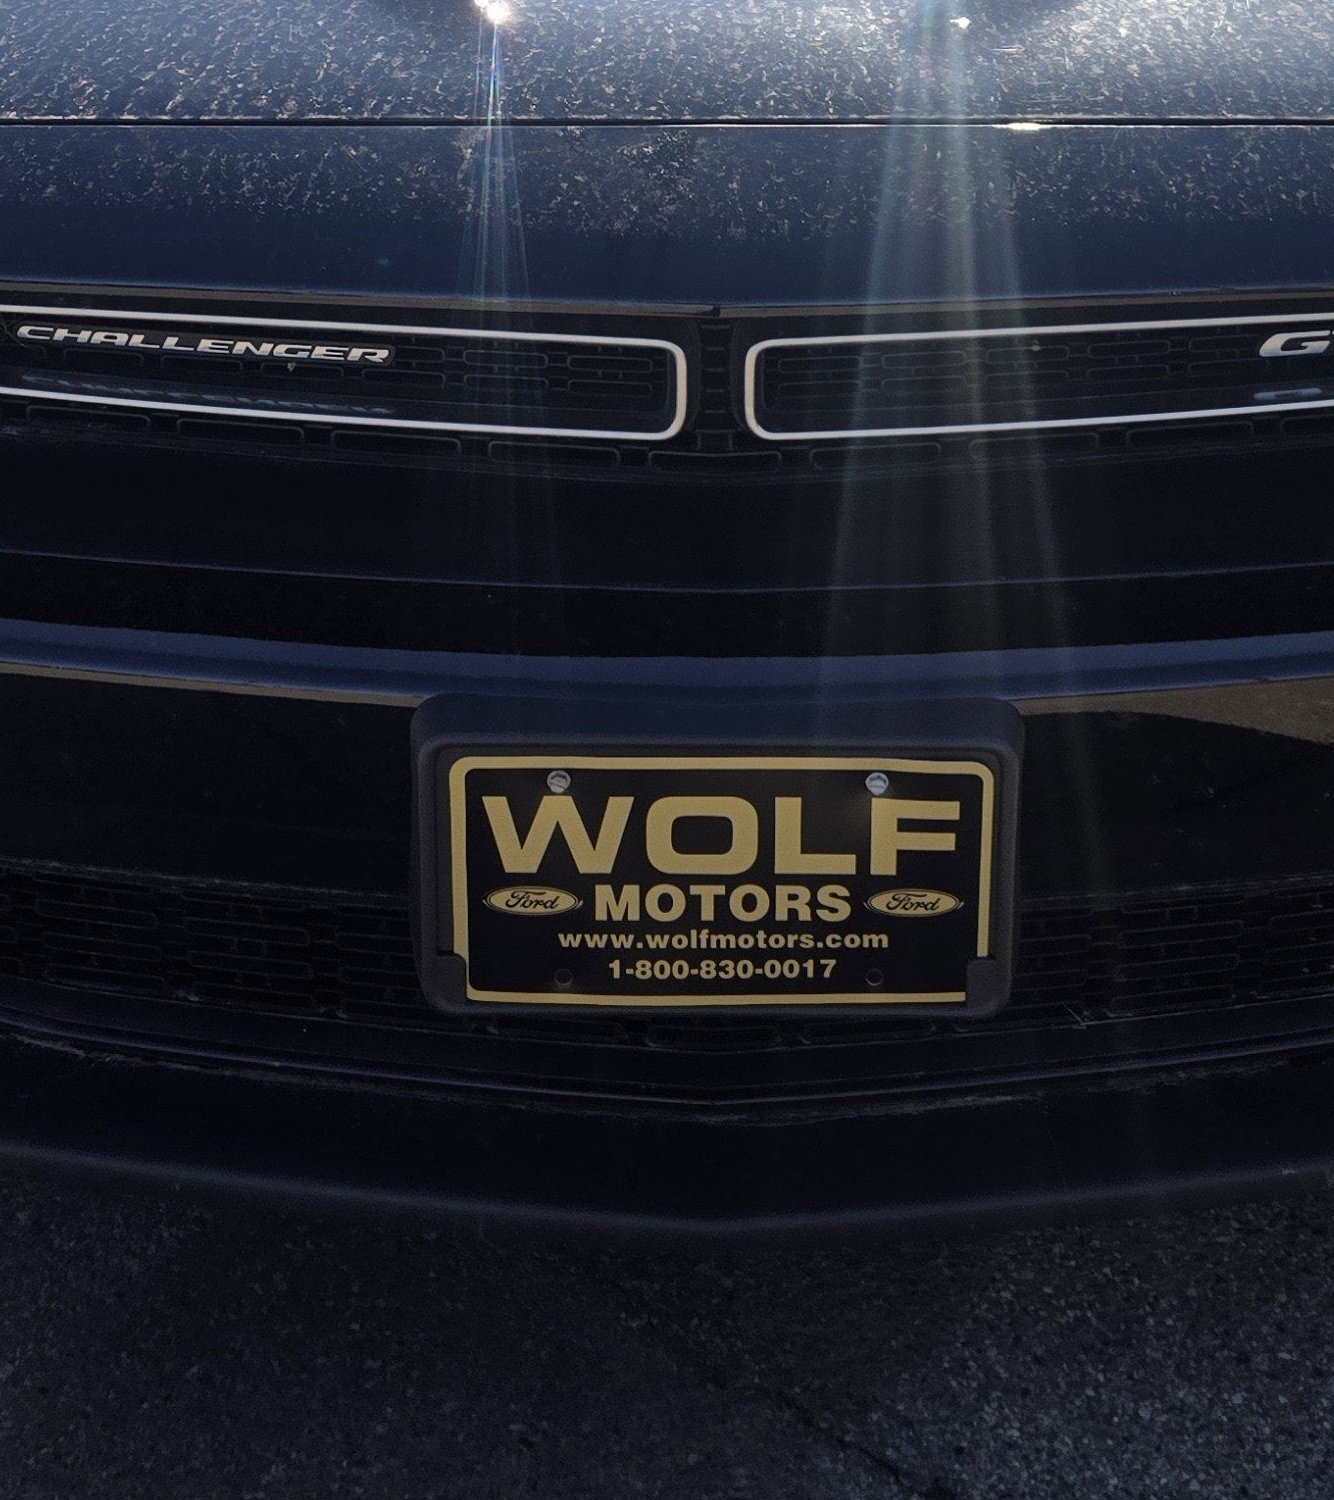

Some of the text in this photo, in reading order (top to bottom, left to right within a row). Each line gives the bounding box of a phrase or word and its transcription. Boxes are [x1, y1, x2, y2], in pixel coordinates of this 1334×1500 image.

[17, 324, 391, 364] CHALLENGER
[482, 795, 961, 876] WOLF
[504, 889, 560, 913] Ford
[594, 883, 852, 923] MOTORS
[885, 891, 940, 914] Ford
[557, 928, 889, 950] www.wolfmotors.com
[608, 959, 837, 980] 1-800-830-0017
